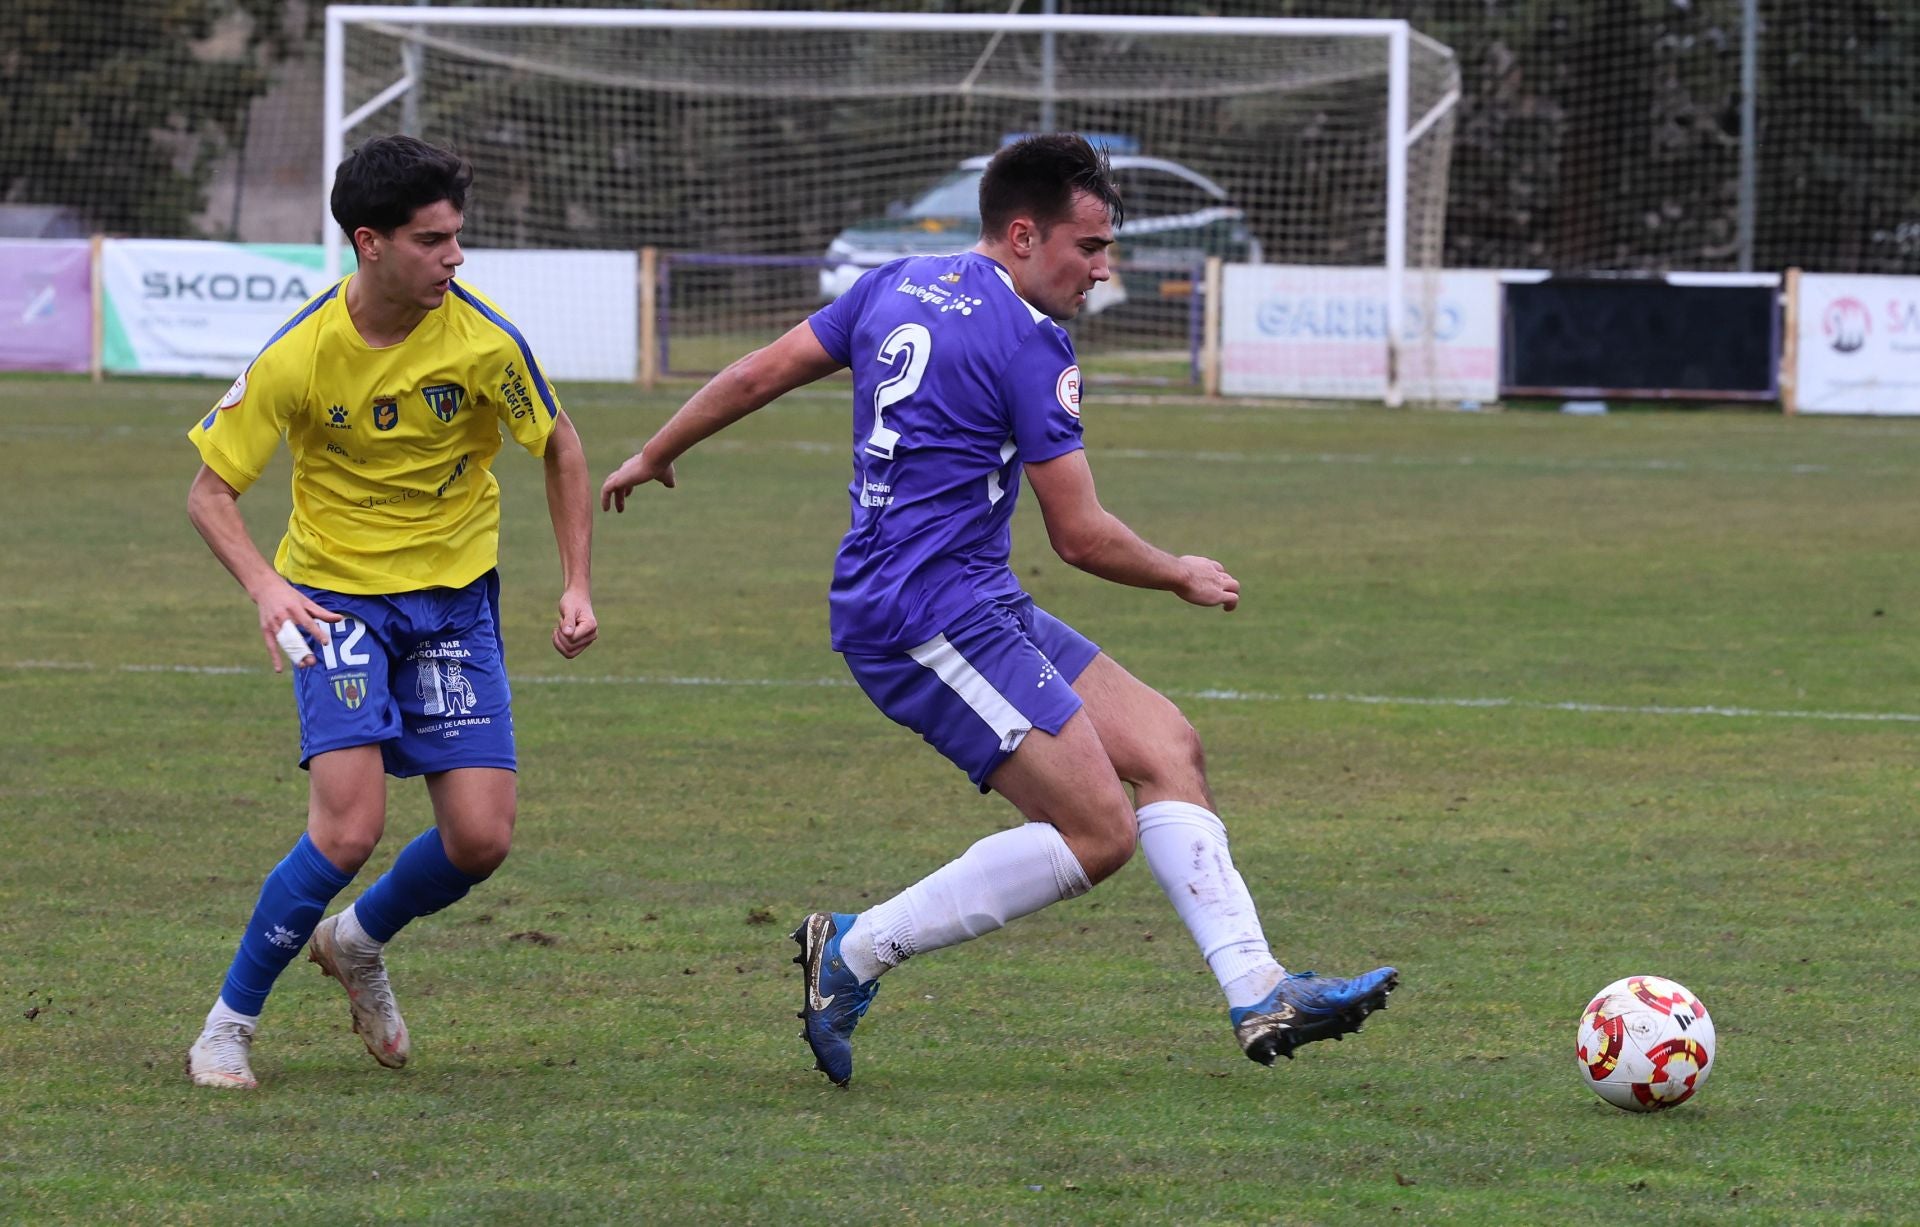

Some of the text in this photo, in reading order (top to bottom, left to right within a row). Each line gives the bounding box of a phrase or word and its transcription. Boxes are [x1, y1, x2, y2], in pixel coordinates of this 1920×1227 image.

[864, 322, 932, 460] 2
[314, 617, 370, 669] 12
[444, 721, 453, 729] DE
[453, 719, 467, 727] LAS
[467, 717, 491, 726] MULAS
